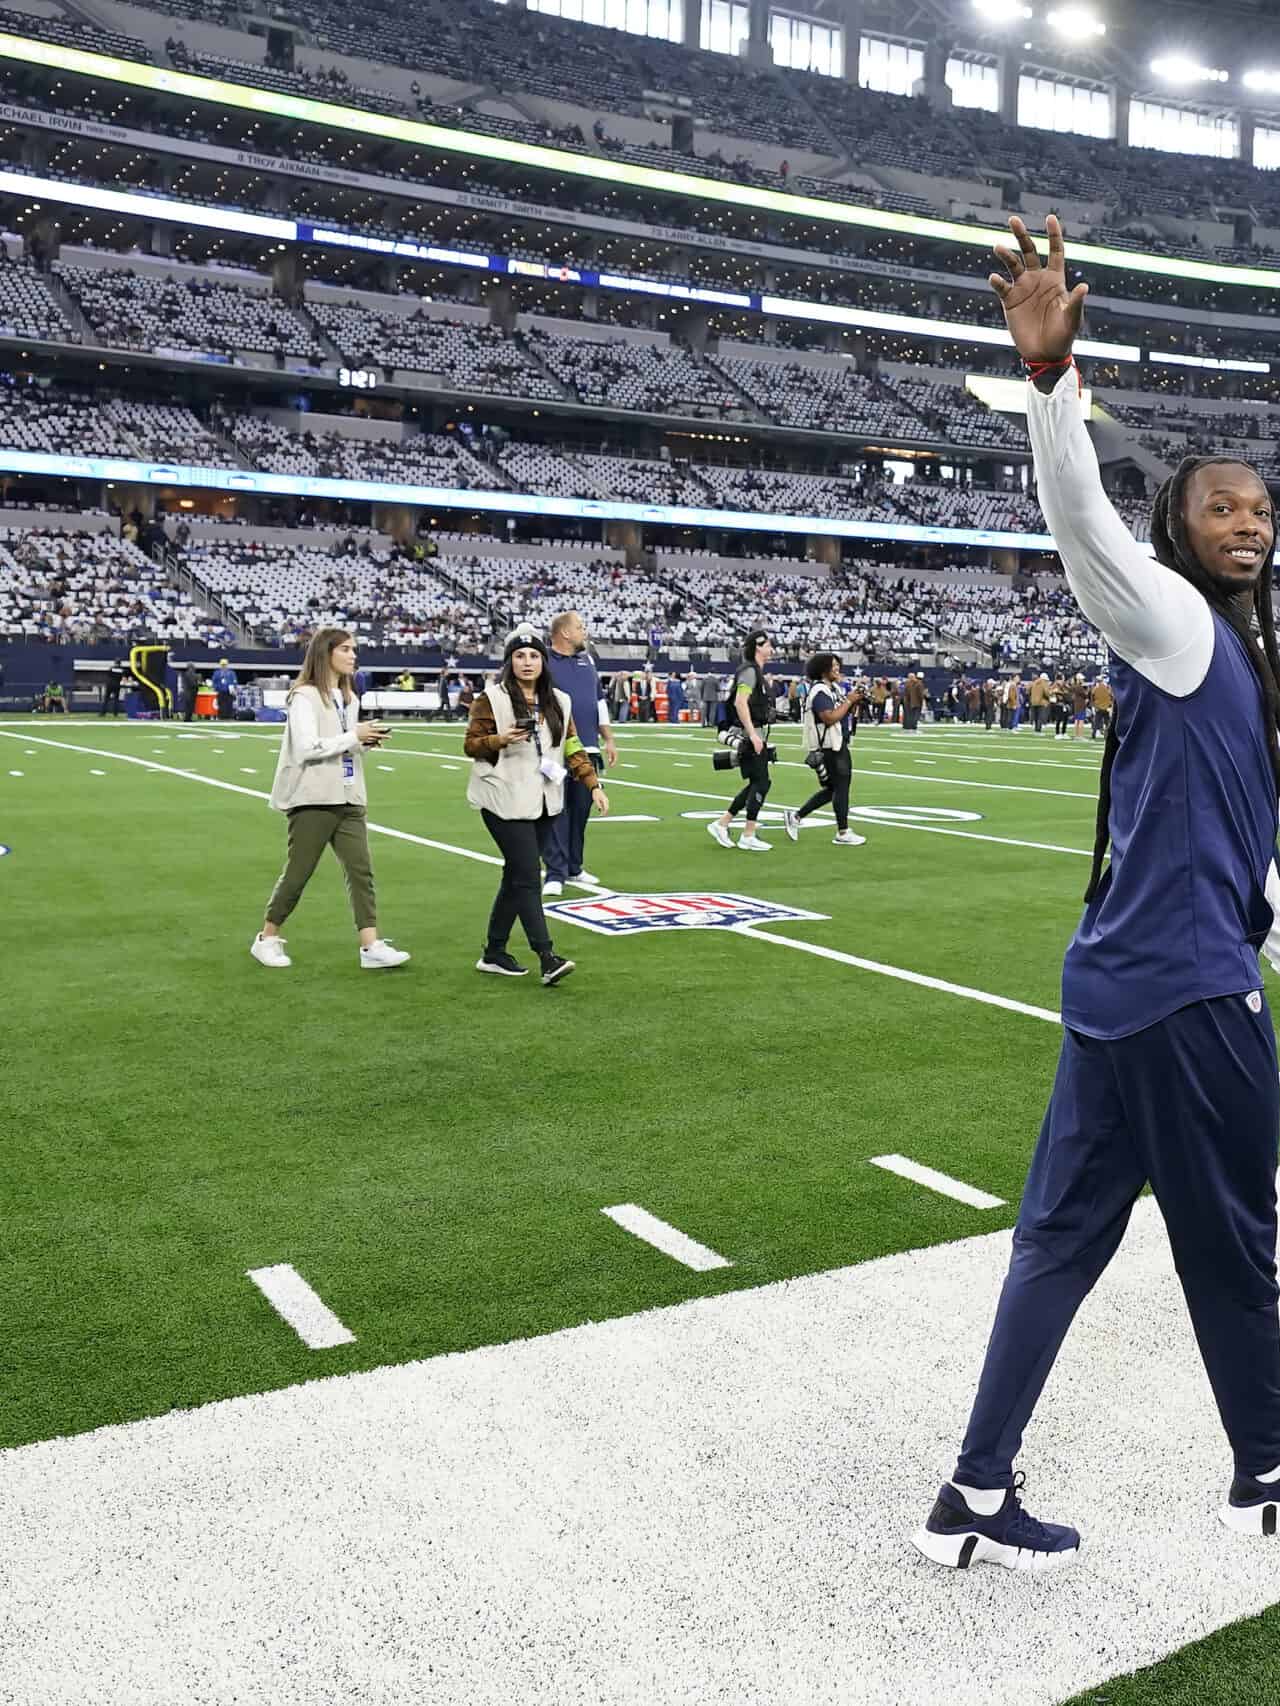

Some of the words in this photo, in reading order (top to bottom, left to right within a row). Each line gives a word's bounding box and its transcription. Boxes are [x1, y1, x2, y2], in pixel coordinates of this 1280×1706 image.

[48, 116, 82, 131] IRVIN
[246, 153, 276, 167] TROY
[567, 897, 737, 916] NFL
